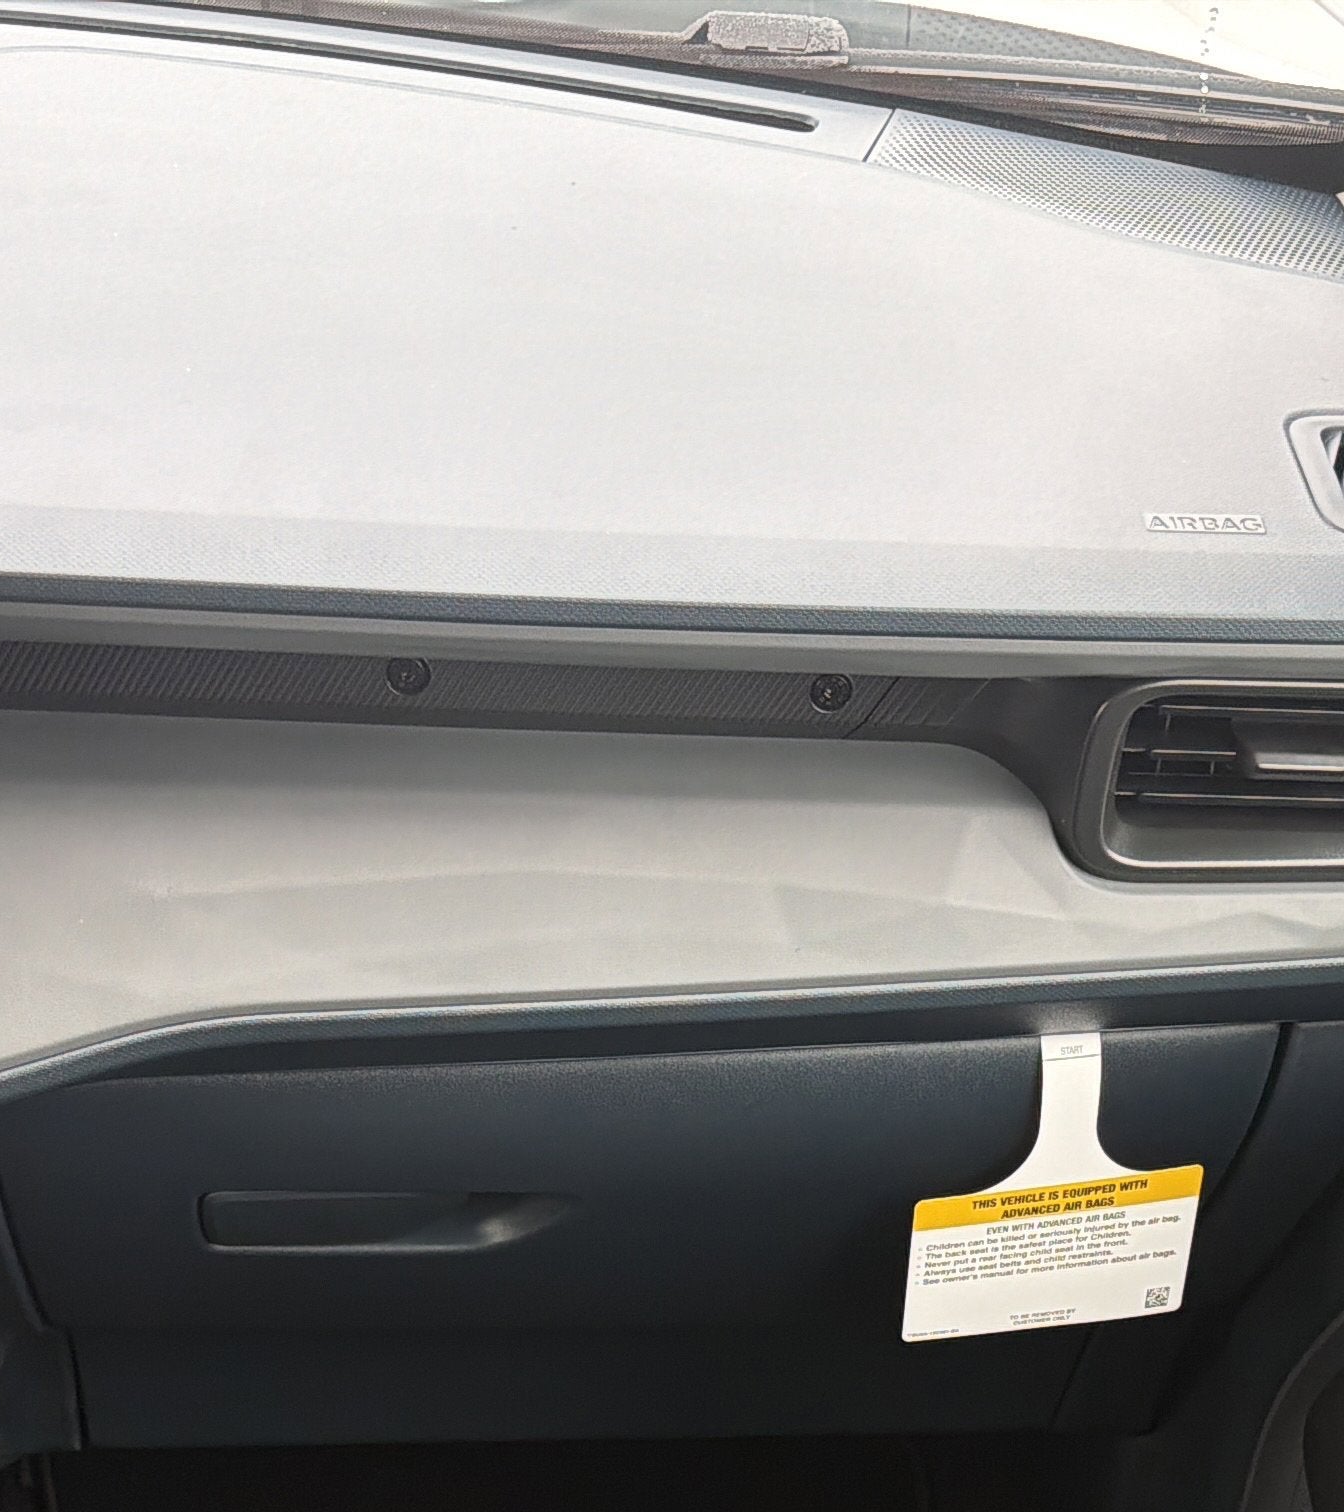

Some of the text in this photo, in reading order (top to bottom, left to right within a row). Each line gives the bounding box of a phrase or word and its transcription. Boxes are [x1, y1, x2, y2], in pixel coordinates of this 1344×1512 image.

[1149, 515, 1263, 531] AIRBAG
[1060, 1045, 1084, 1055] START
[972, 1179, 1148, 1210] THIS VEHICLE IS EQUIPPED WITH
[1001, 1197, 1115, 1219] ADVANCED AIR BAGS
[926, 1241, 965, 1252] Children
[968, 1239, 984, 1247] can
[1000, 1234, 1025, 1243] killed
[1040, 1227, 1081, 1239] seriously
[1118, 1220, 1129, 1229] by
[1132, 1218, 1146, 1227] the
[1148, 1215, 1160, 1225] air
[1162, 1214, 1181, 1223] bag.
[986, 1211, 1126, 1235] EVEN WITH ADVANCED AIR BAGS
[925, 1260, 951, 1269] Never
[954, 1257, 969, 1266] put
[979, 1254, 997, 1263] rear
[1000, 1251, 1028, 1262] facing
[1030, 1247, 1052, 1257] child
[1055, 1246, 1073, 1254] seat
[1087, 1241, 1101, 1250] the
[926, 1251, 942, 1260] The
[945, 1249, 967, 1258] back
[970, 1246, 988, 1255] seat
[1002, 1243, 1016, 1251] the
[1019, 1239, 1046, 1250] safest
[1048, 1237, 1073, 1247] place
[1076, 1234, 1087, 1243] for
[1090, 1230, 1131, 1240] Children.
[923, 1277, 940, 1286] See
[980, 1269, 1014, 1279] manual
[1016, 1267, 1028, 1275] for
[1031, 1264, 1054, 1273] more
[1057, 1258, 1108, 1270] information
[1111, 1254, 1136, 1264] about
[1139, 1251, 1151, 1260] air
[924, 1267, 957, 1277] Always
[959, 1266, 976, 1274] use
[978, 1263, 997, 1271] seat
[1000, 1260, 1021, 1268] belts
[1024, 1257, 1041, 1265] and
[1044, 1253, 1066, 1263] child
